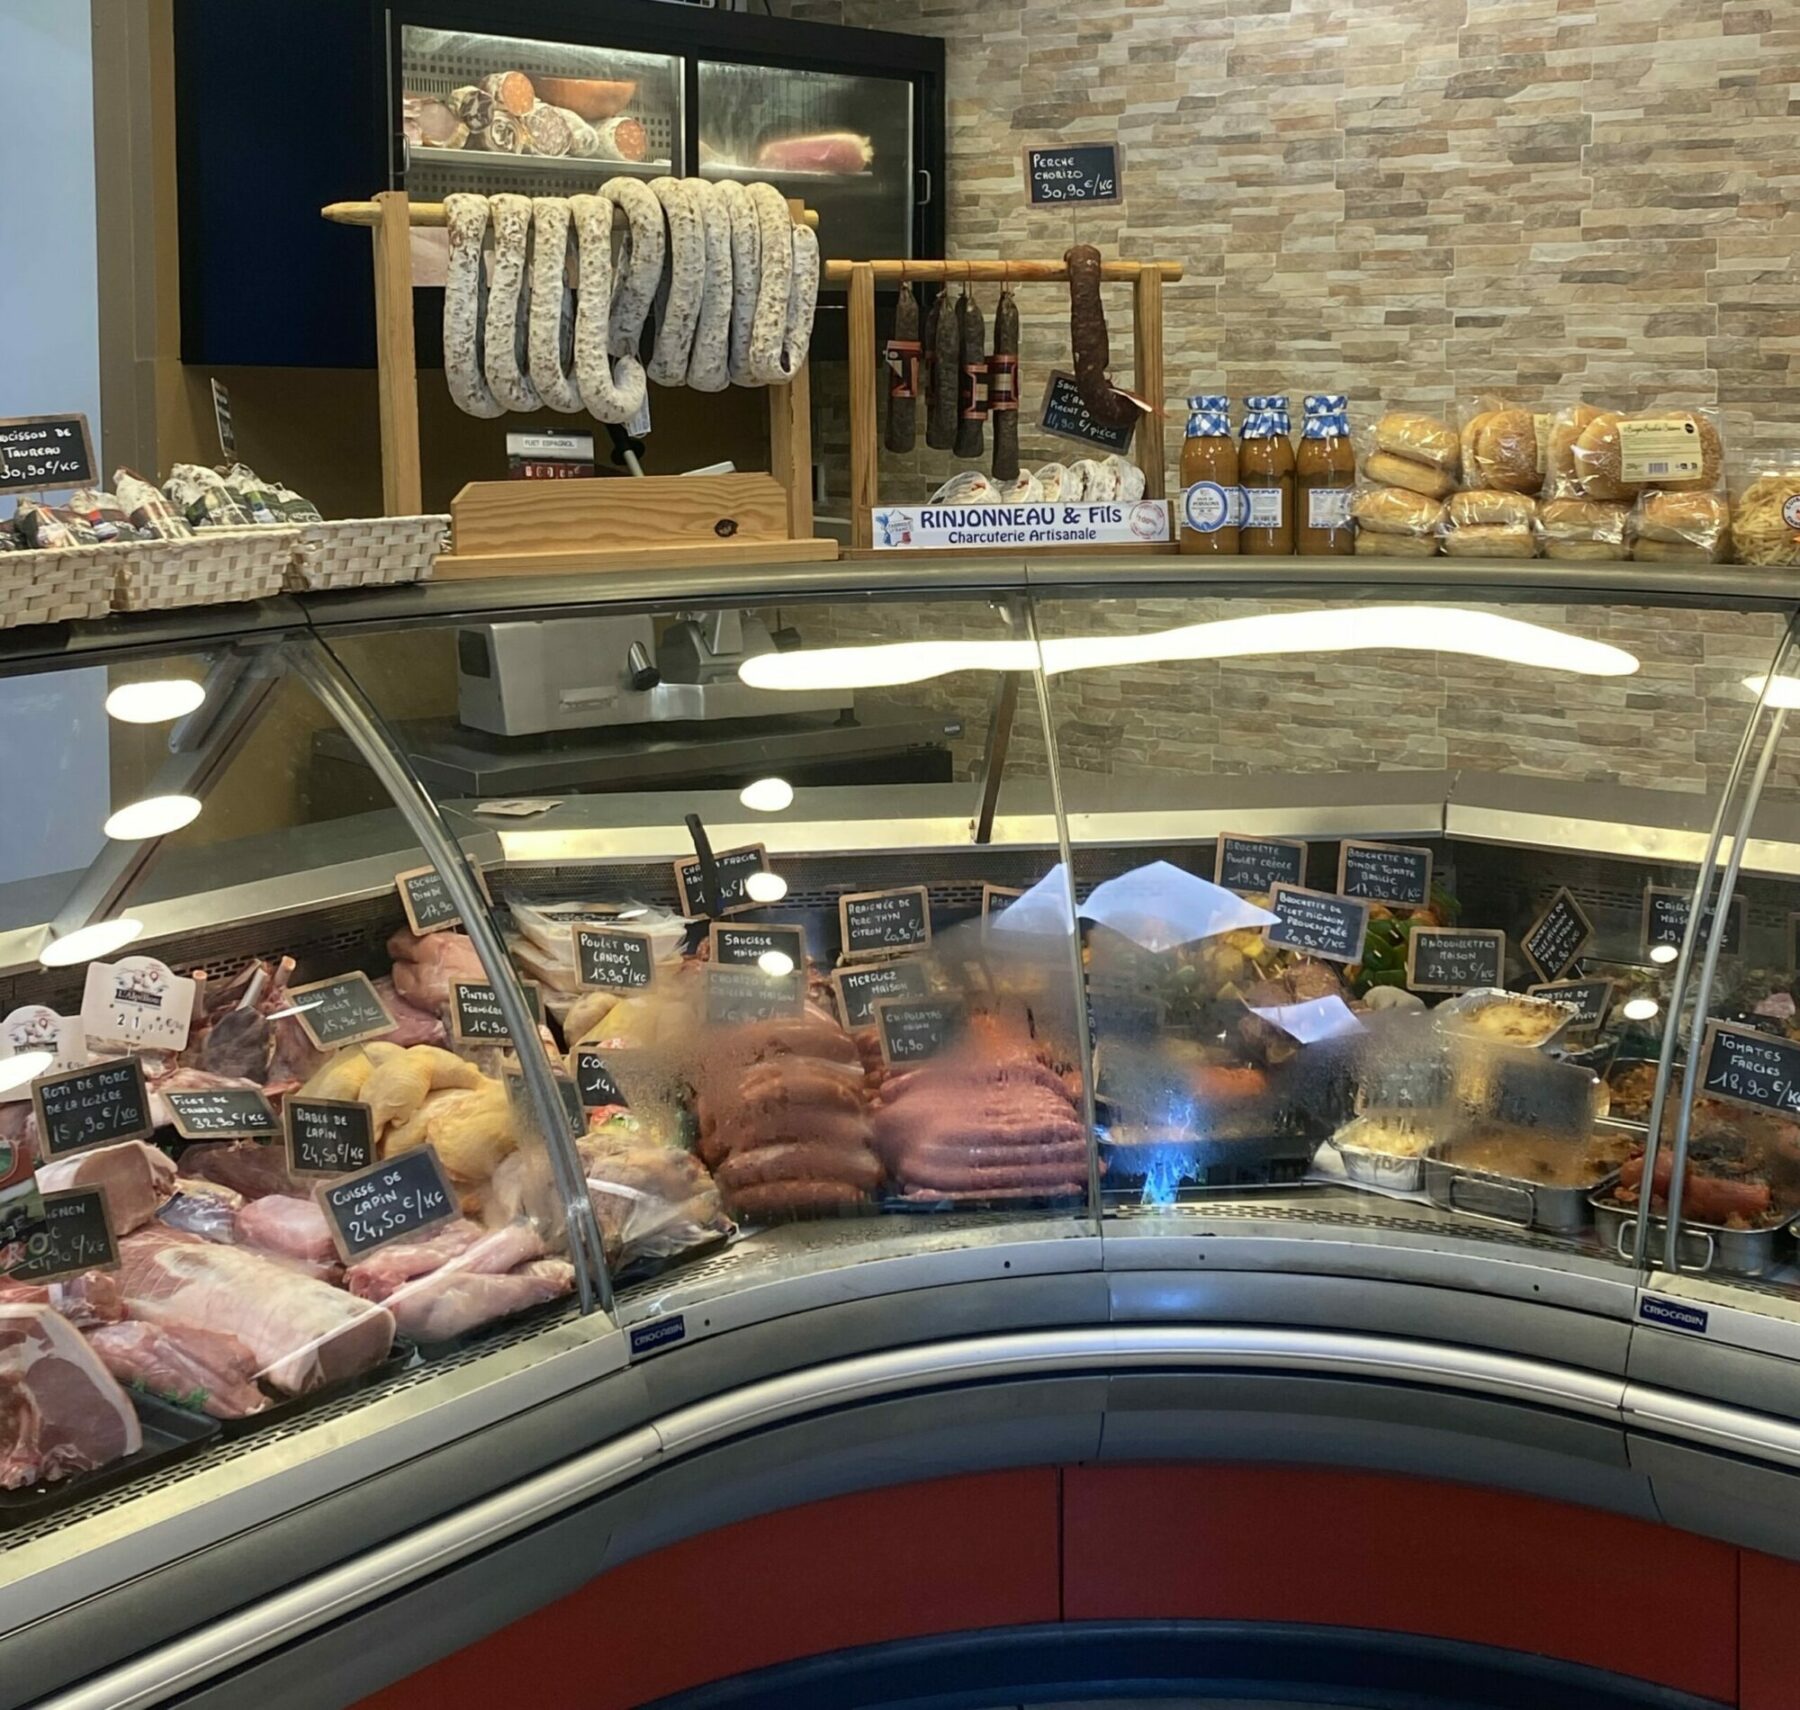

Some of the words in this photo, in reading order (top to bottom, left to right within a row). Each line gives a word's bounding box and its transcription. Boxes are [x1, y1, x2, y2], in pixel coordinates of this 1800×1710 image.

[1033, 153, 1075, 168] PERCHE
[1057, 380, 1078, 393] SAUC
[54, 428, 72, 437] DE
[3, 446, 60, 458] TAUREAU
[921, 507, 1055, 529] RINJONNEAU
[1062, 507, 1081, 524] &
[1089, 505, 1122, 524] Fils
[948, 529, 1025, 544] Charcuterie
[1029, 527, 1096, 541] Artisanale
[725, 934, 772, 946] SAUCISSE
[593, 951, 631, 965] LANDES
[848, 971, 897, 988] MERGUEZ
[1718, 1032, 1781, 1062] TOMATES
[1730, 1055, 1780, 1077] FARCIES
[77, 1079, 93, 1091] DE
[99, 1070, 129, 1086] PORC
[65, 1100, 78, 1111] LA
[334, 1115, 347, 1126] DE
[306, 1126, 336, 1140] LAPIN
[333, 1182, 375, 1206] CUISSE
[383, 1171, 402, 1186] DE
[354, 1189, 397, 1215] LAPIN
[1643, 1304, 1704, 1326] CRIOCABIN
